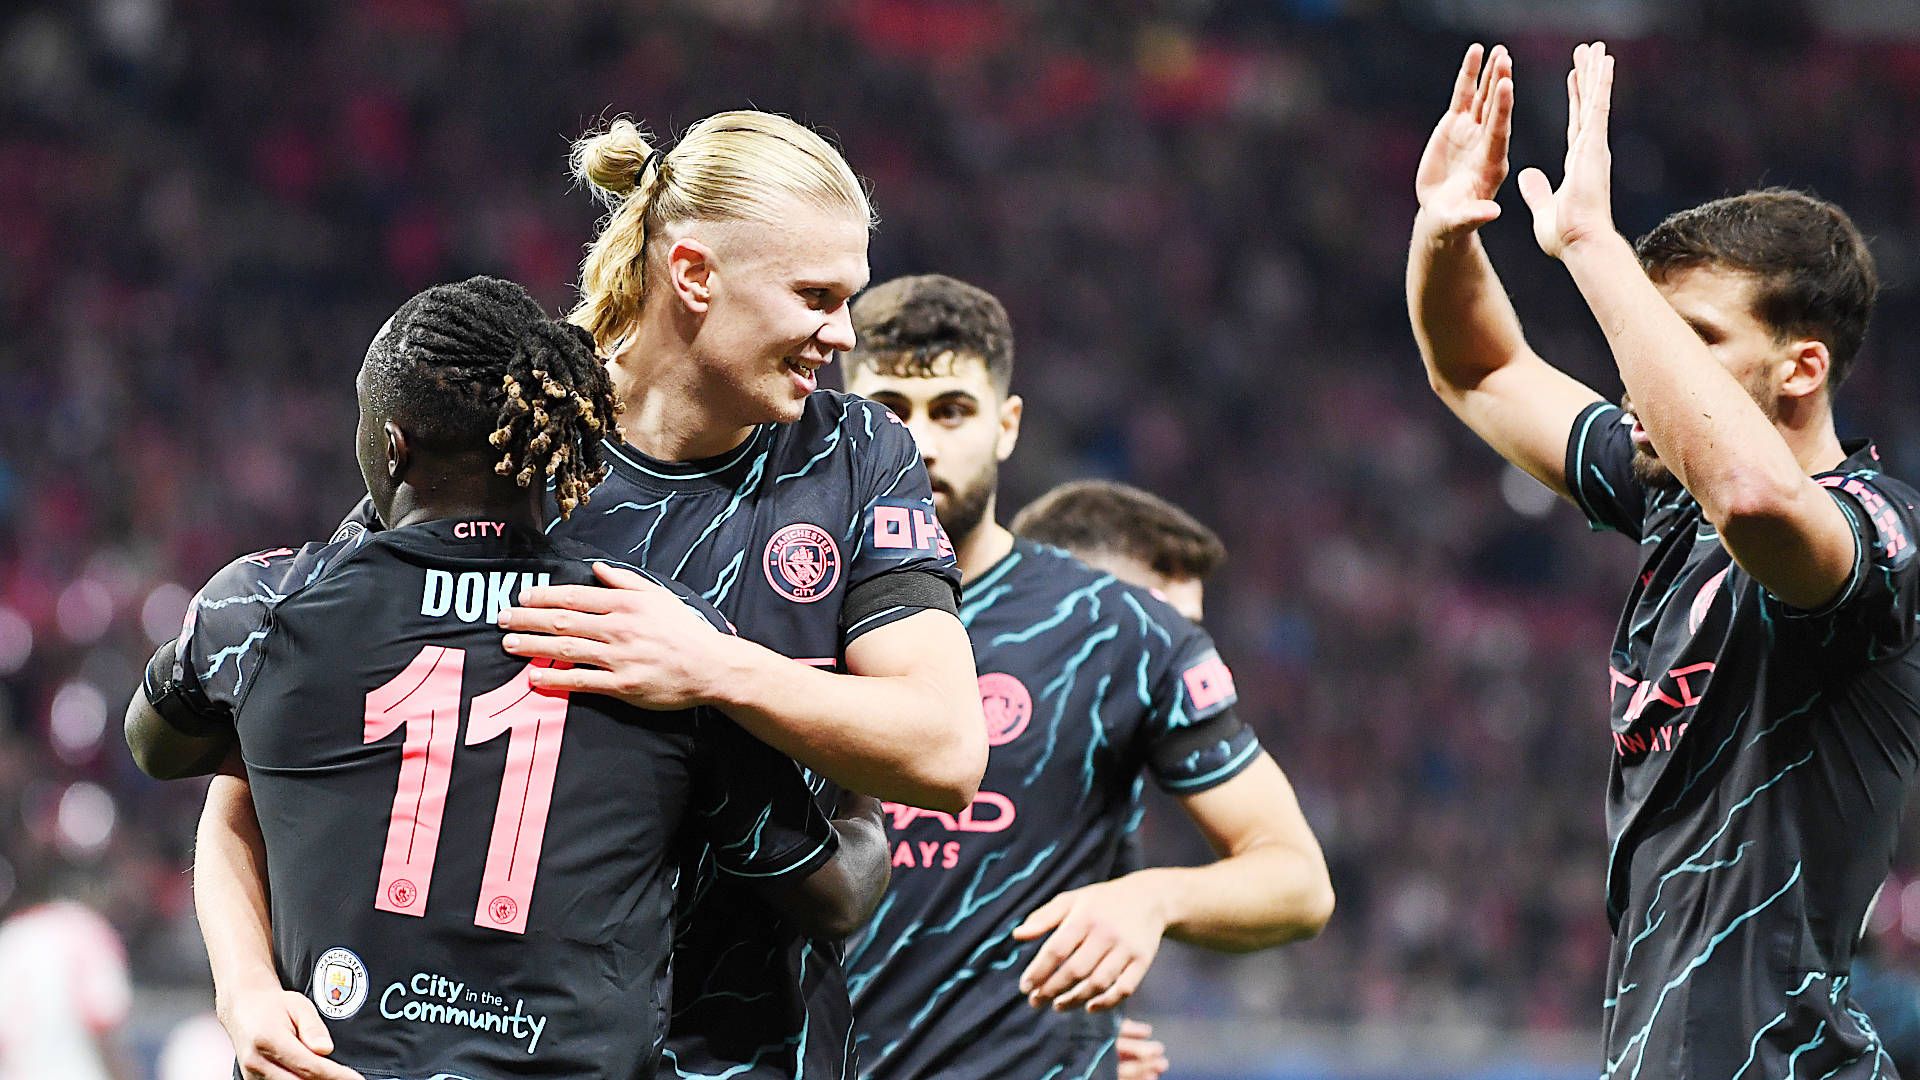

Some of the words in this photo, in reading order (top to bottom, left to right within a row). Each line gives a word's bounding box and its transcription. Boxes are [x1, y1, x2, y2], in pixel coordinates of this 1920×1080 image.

[453, 521, 506, 539] CITY
[771, 529, 832, 554] MANCHESTER
[420, 568, 551, 625] DOK
[792, 588, 816, 597] CITY
[363, 644, 574, 935] 11
[887, 840, 960, 869] AYS
[410, 972, 465, 1004] City
[465, 988, 478, 1002] in
[481, 991, 503, 1007] the
[379, 981, 547, 1055] Community
